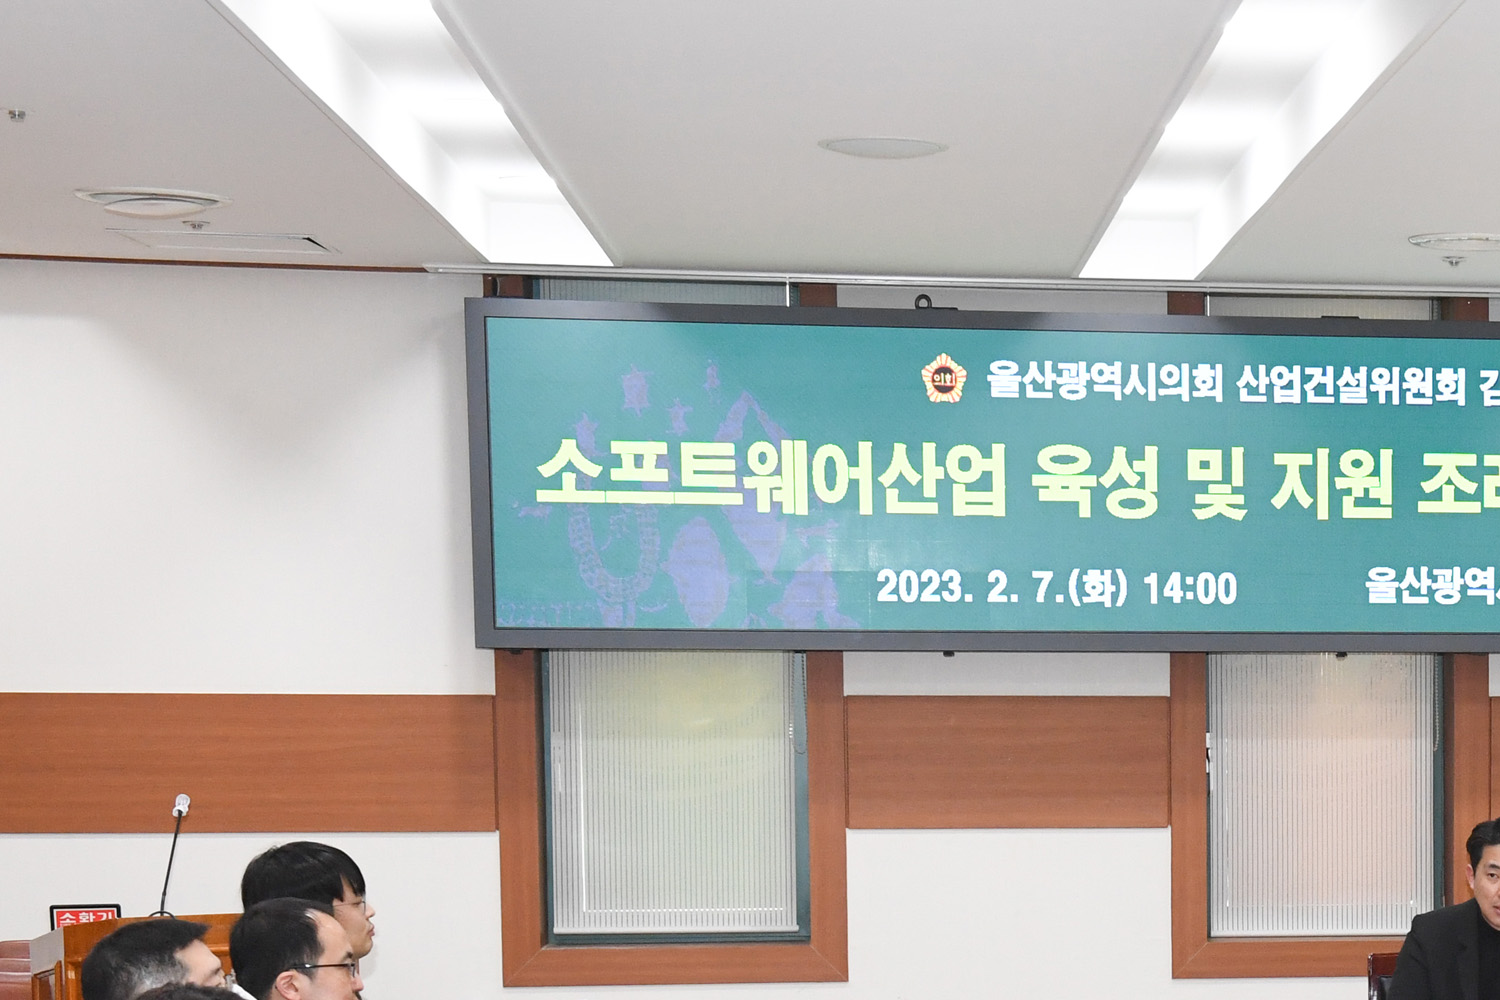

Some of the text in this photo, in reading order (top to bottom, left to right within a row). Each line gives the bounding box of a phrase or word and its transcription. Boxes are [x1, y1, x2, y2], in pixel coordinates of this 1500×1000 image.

[986, 360, 1225, 405] 울산광역시의회
[1236, 364, 1468, 408] 산업건설위원회
[536, 438, 1009, 519] 소프트웨어산업
[1031, 444, 1161, 521] 육성
[1187, 446, 1250, 523] 및
[1270, 448, 1395, 522] 지원
[876, 568, 1239, 610] 2023. 2. 7.(화) 14:00
[59, 912, 112, 924] 소화기
